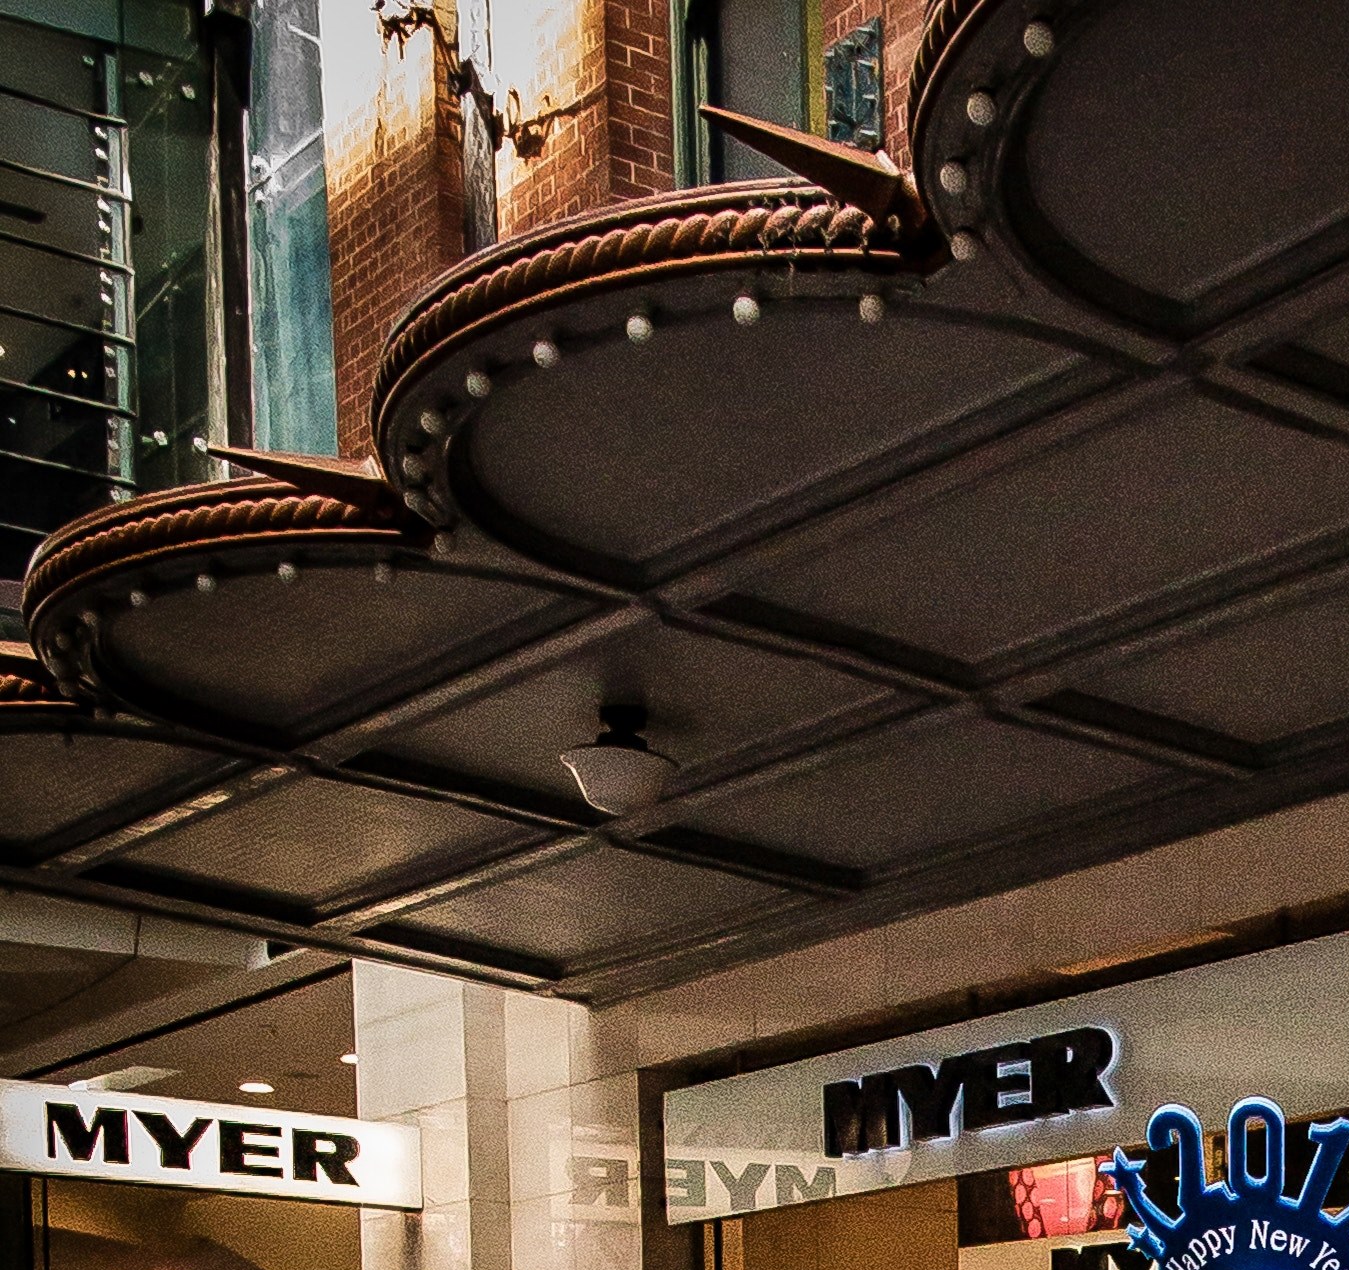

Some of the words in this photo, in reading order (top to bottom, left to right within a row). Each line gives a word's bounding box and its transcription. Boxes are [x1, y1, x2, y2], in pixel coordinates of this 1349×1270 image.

[822, 1025, 1117, 1158] MYER
[45, 1101, 362, 1188] MYER
[1249, 1219, 1311, 1258] New
